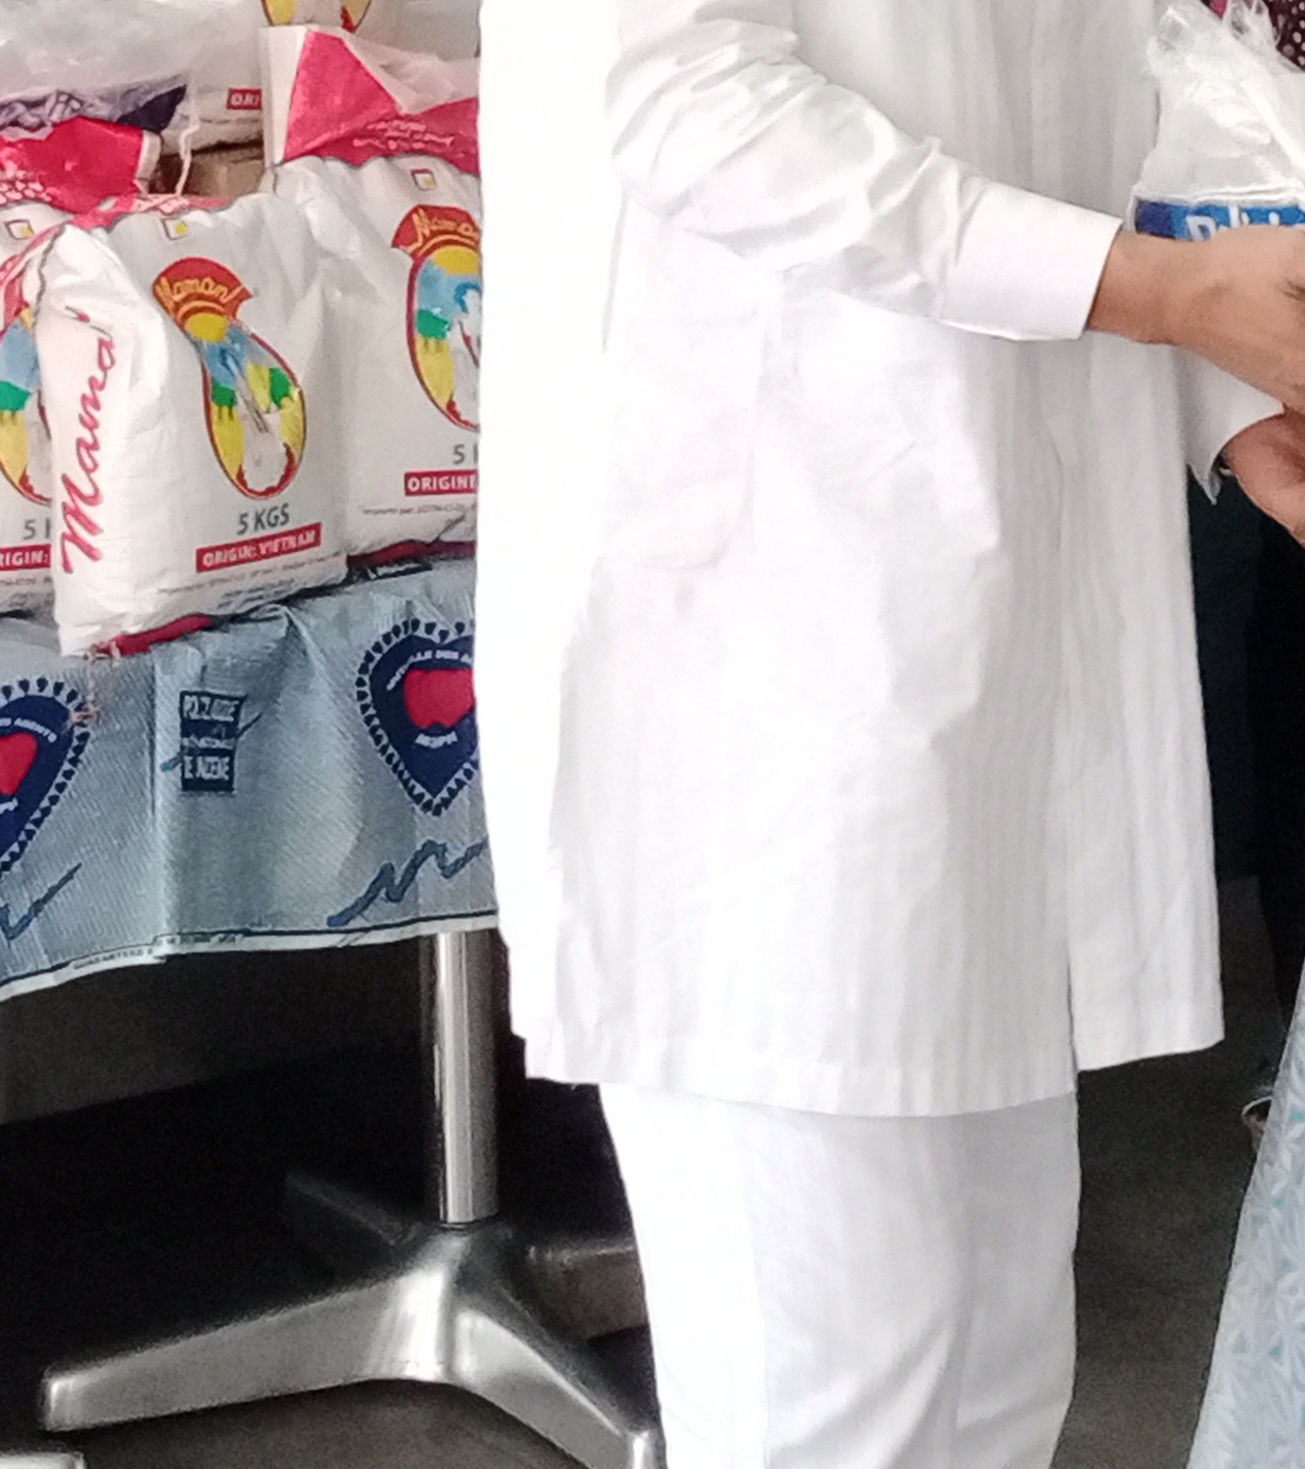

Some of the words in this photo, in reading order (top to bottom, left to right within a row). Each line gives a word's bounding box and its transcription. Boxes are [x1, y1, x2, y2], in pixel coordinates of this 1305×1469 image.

[399, 207, 480, 253] Mama
[60, 305, 116, 574] Mama
[453, 443, 465, 465] 5
[23, 518, 36, 540] 5
[237, 513, 249, 535] 5
[254, 503, 290, 531] KGS
